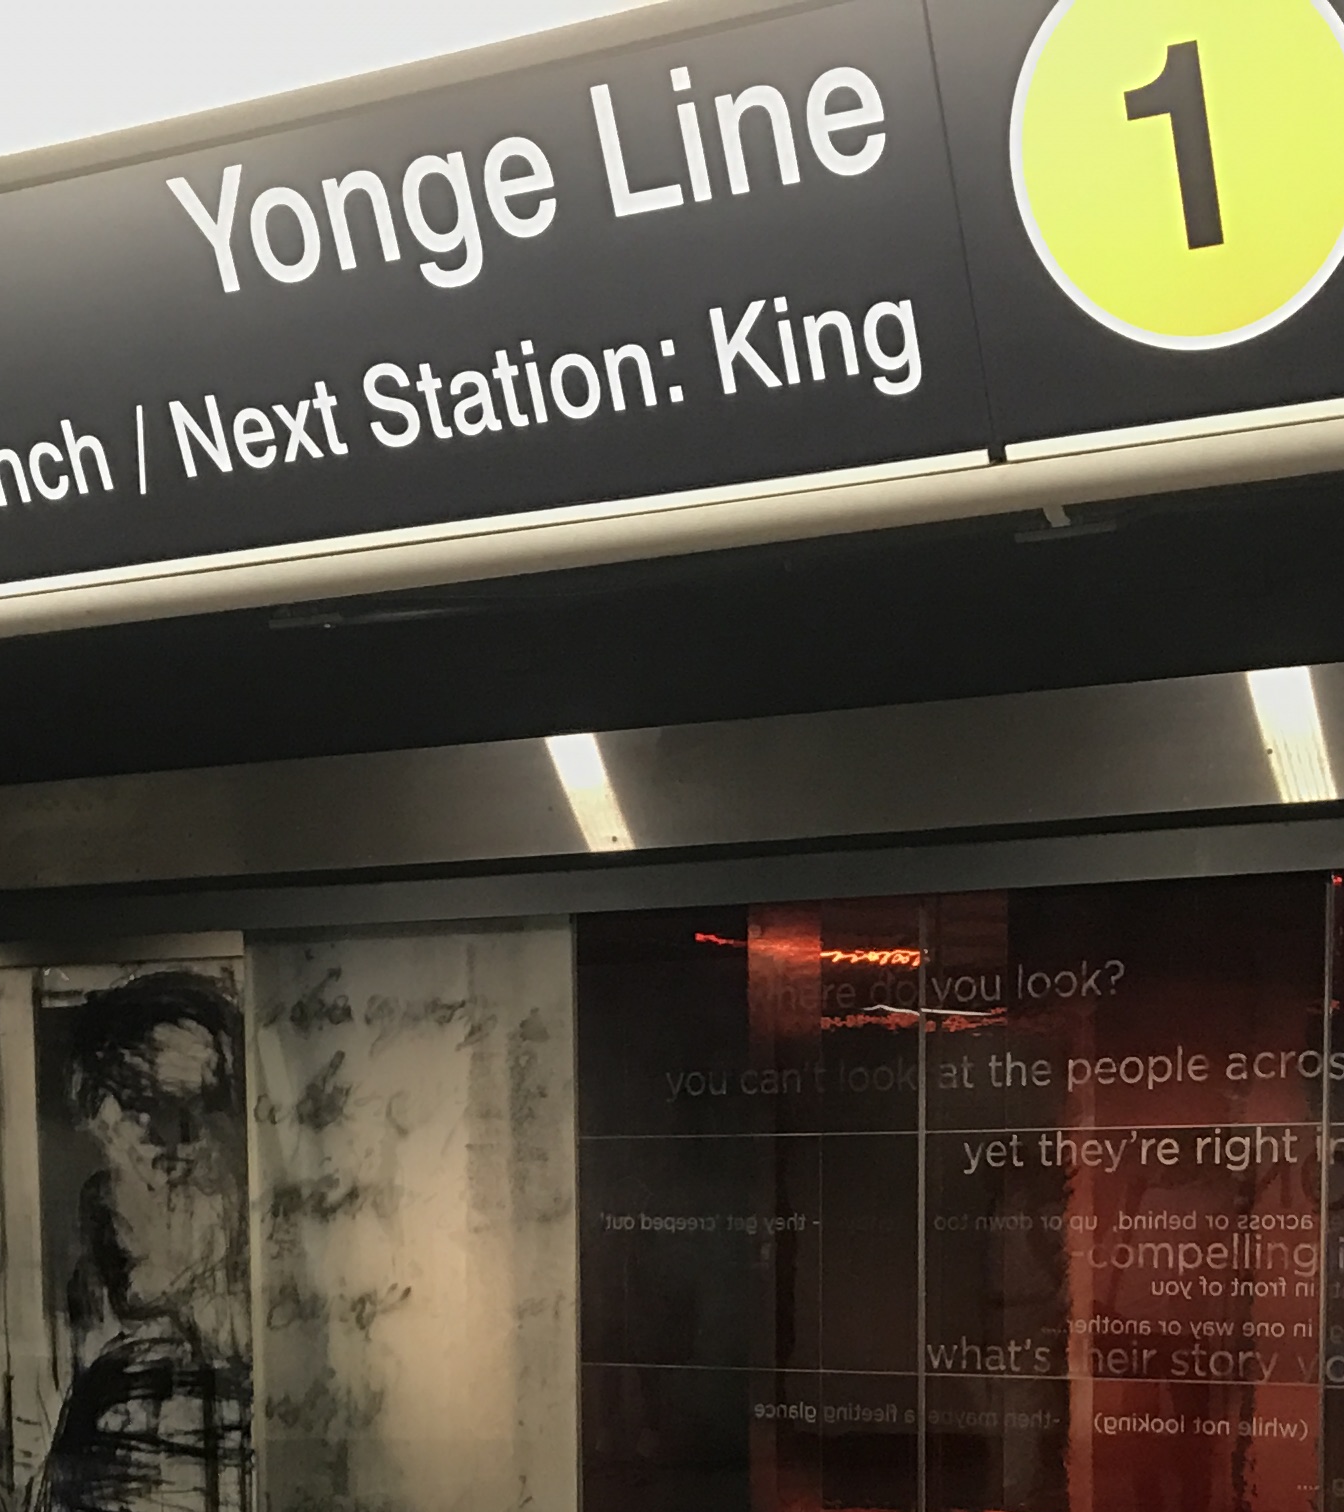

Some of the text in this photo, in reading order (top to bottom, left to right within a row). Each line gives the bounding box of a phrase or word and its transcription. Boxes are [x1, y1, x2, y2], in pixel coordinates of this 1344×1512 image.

[1124, 39, 1228, 252] 1
[165, 65, 887, 292] Yonge Line
[135, 404, 147, 496] /
[169, 380, 349, 478] Next
[362, 338, 686, 448] Station:
[710, 296, 923, 397] King
[931, 968, 1003, 1003] you
[1017, 958, 1126, 998] look?
[665, 1067, 728, 1104] you
[739, 1059, 827, 1097] can't
[838, 1056, 918, 1092] look
[937, 1056, 974, 1090] at
[988, 1050, 1053, 1088] the
[1066, 1043, 1210, 1093] people
[962, 1134, 1025, 1176] yet
[1037, 1130, 1181, 1174] they're
[1195, 1126, 1298, 1172] right
[925, 1335, 1052, 1373] what's
[1169, 1343, 1279, 1383] story
